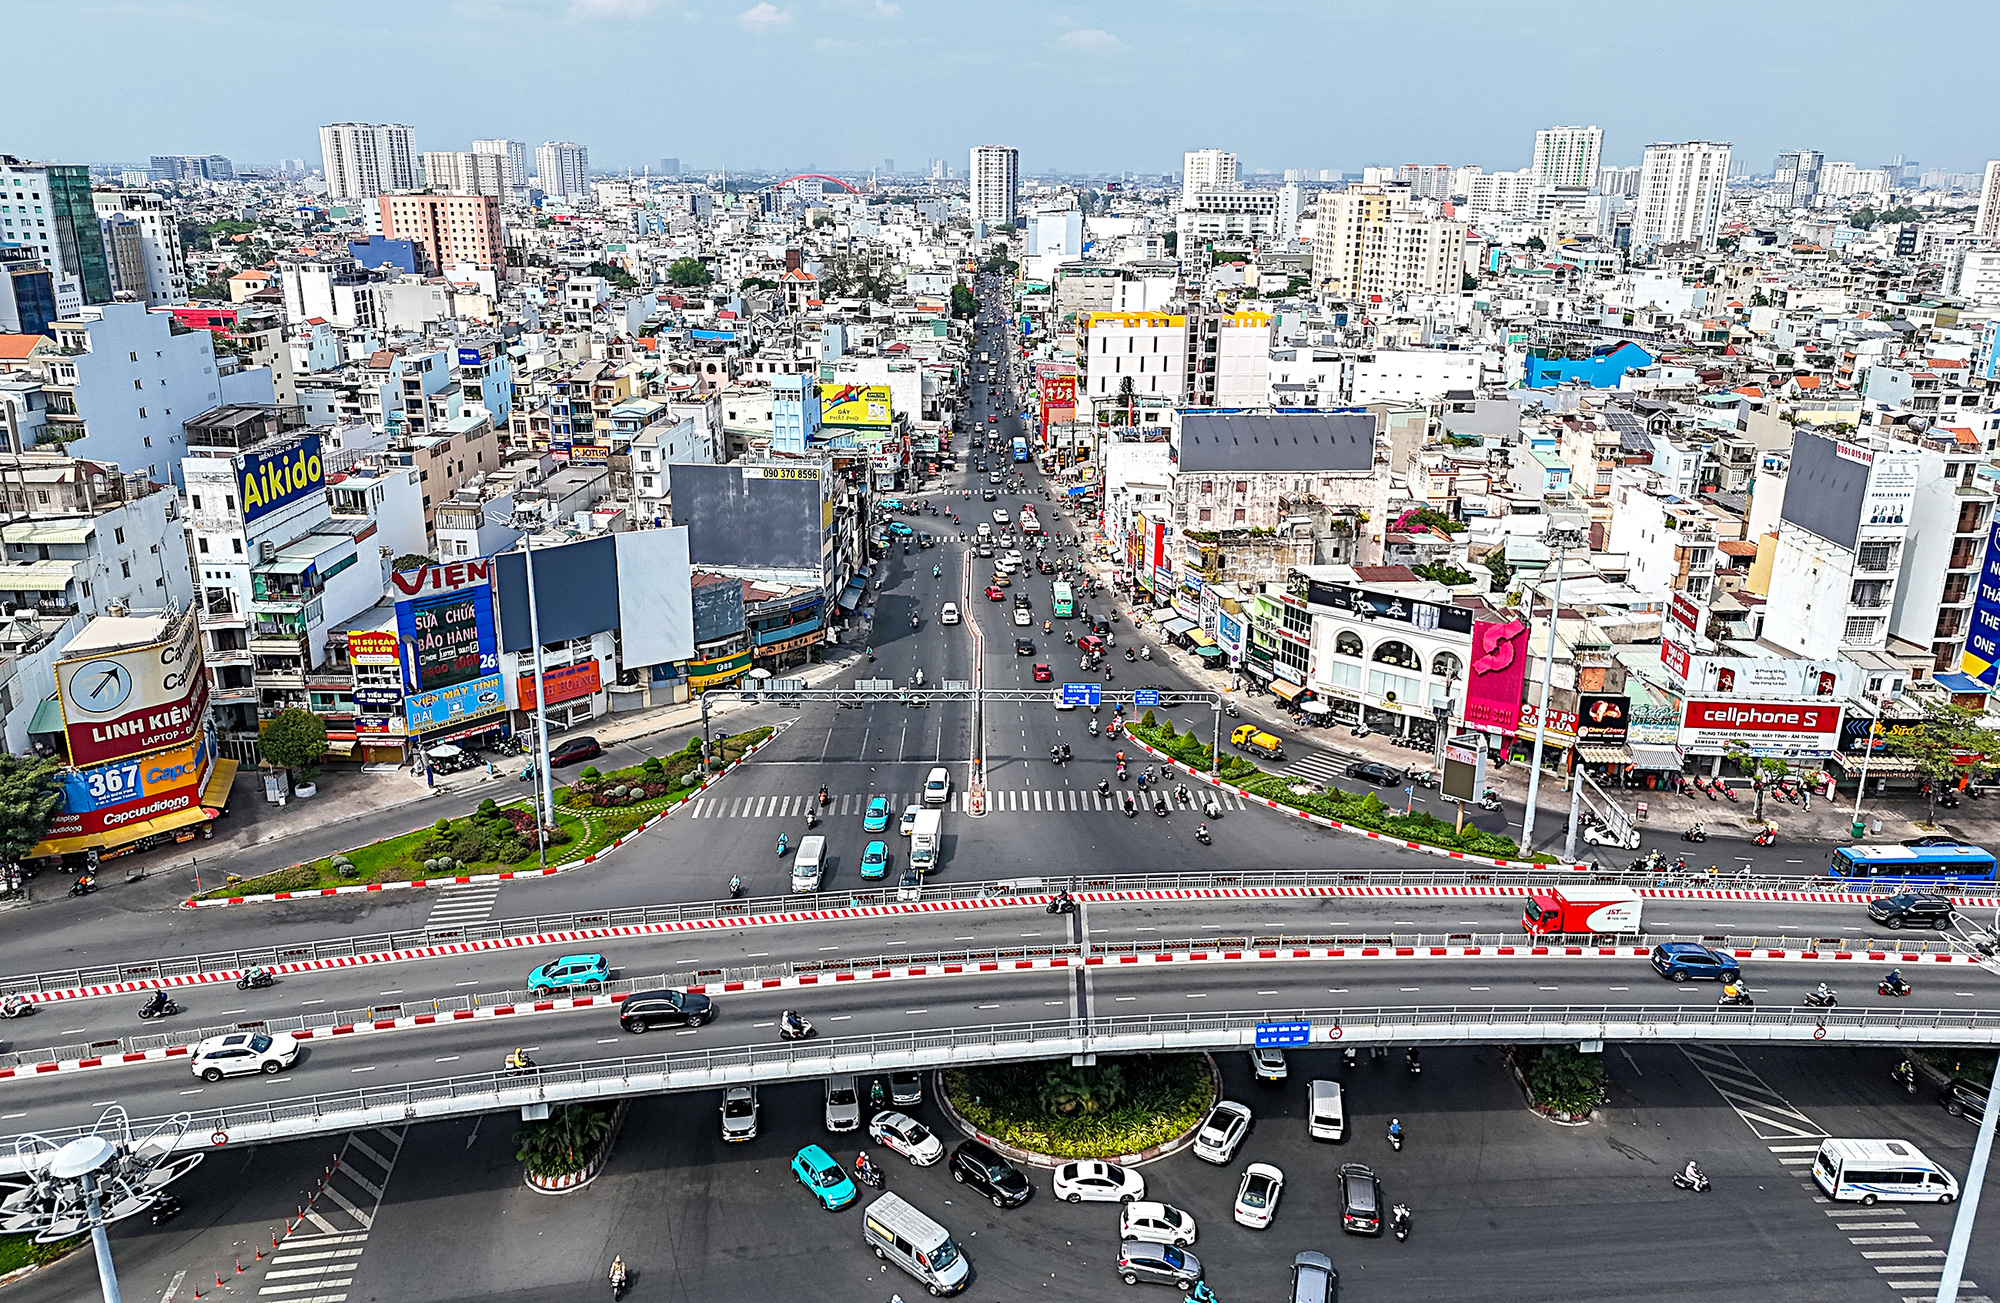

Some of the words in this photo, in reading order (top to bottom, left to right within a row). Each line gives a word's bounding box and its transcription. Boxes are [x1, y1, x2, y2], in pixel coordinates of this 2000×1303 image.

[244, 449, 321, 513] Aikido
[764, 468, 778, 478] 090
[781, 469, 795, 478] 370
[798, 470, 817, 479] 8596
[390, 558, 488, 595] VIỆN
[1980, 610, 2000, 631] THE
[418, 629, 443, 652] BẢO
[446, 626, 478, 645] HÀNH
[1973, 635, 1996, 655] ONE
[443, 686, 468, 699] MÁY
[472, 678, 499, 692] TÍNH
[525, 684, 555, 700] VH
[558, 673, 597, 692] HOÀNG
[1380, 700, 1402, 711] Legend
[1470, 704, 1491, 720] NÓN
[92, 722, 144, 743] LINH
[150, 704, 191, 729] KIỆN
[1561, 712, 1576, 722] BÒ
[142, 730, 179, 746] LAPTOP
[88, 764, 138, 797] 367
[103, 795, 189, 825] Capcuudidong
